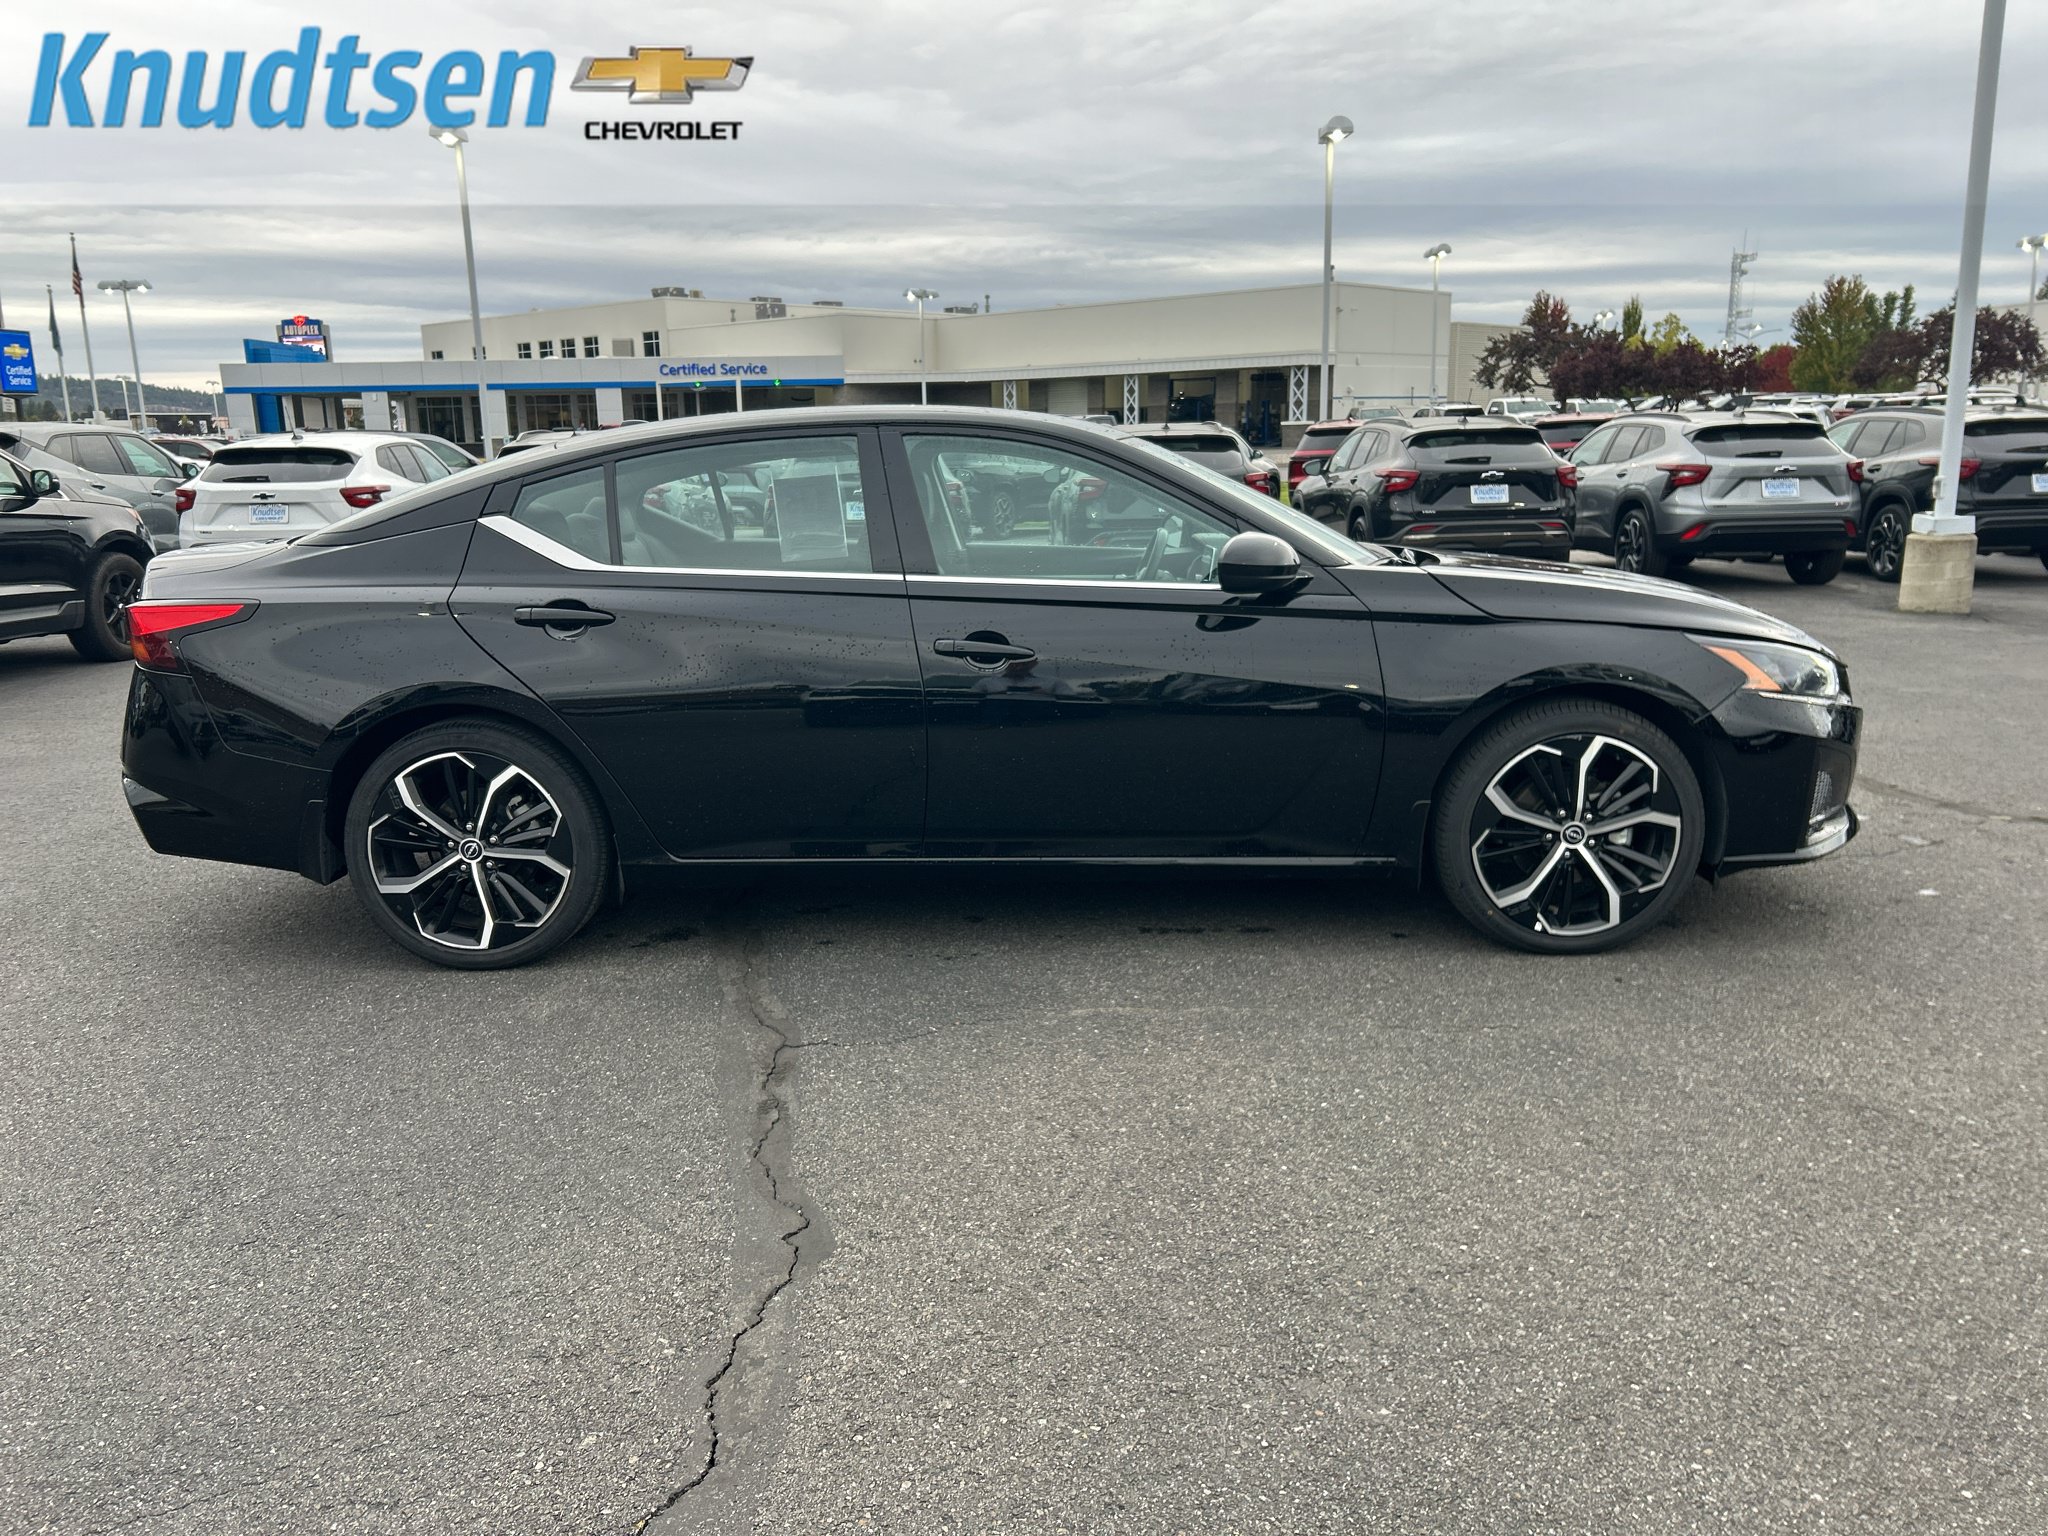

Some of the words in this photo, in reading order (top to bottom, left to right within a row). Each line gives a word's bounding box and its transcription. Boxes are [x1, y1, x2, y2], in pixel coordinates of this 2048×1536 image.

[284, 325, 320, 336] AUTOPLEX
[5, 366, 33, 376] Certified
[659, 363, 716, 376] Certified
[720, 363, 768, 376] Service
[9, 375, 33, 386] Service
[252, 507, 286, 516] Knudtsen
